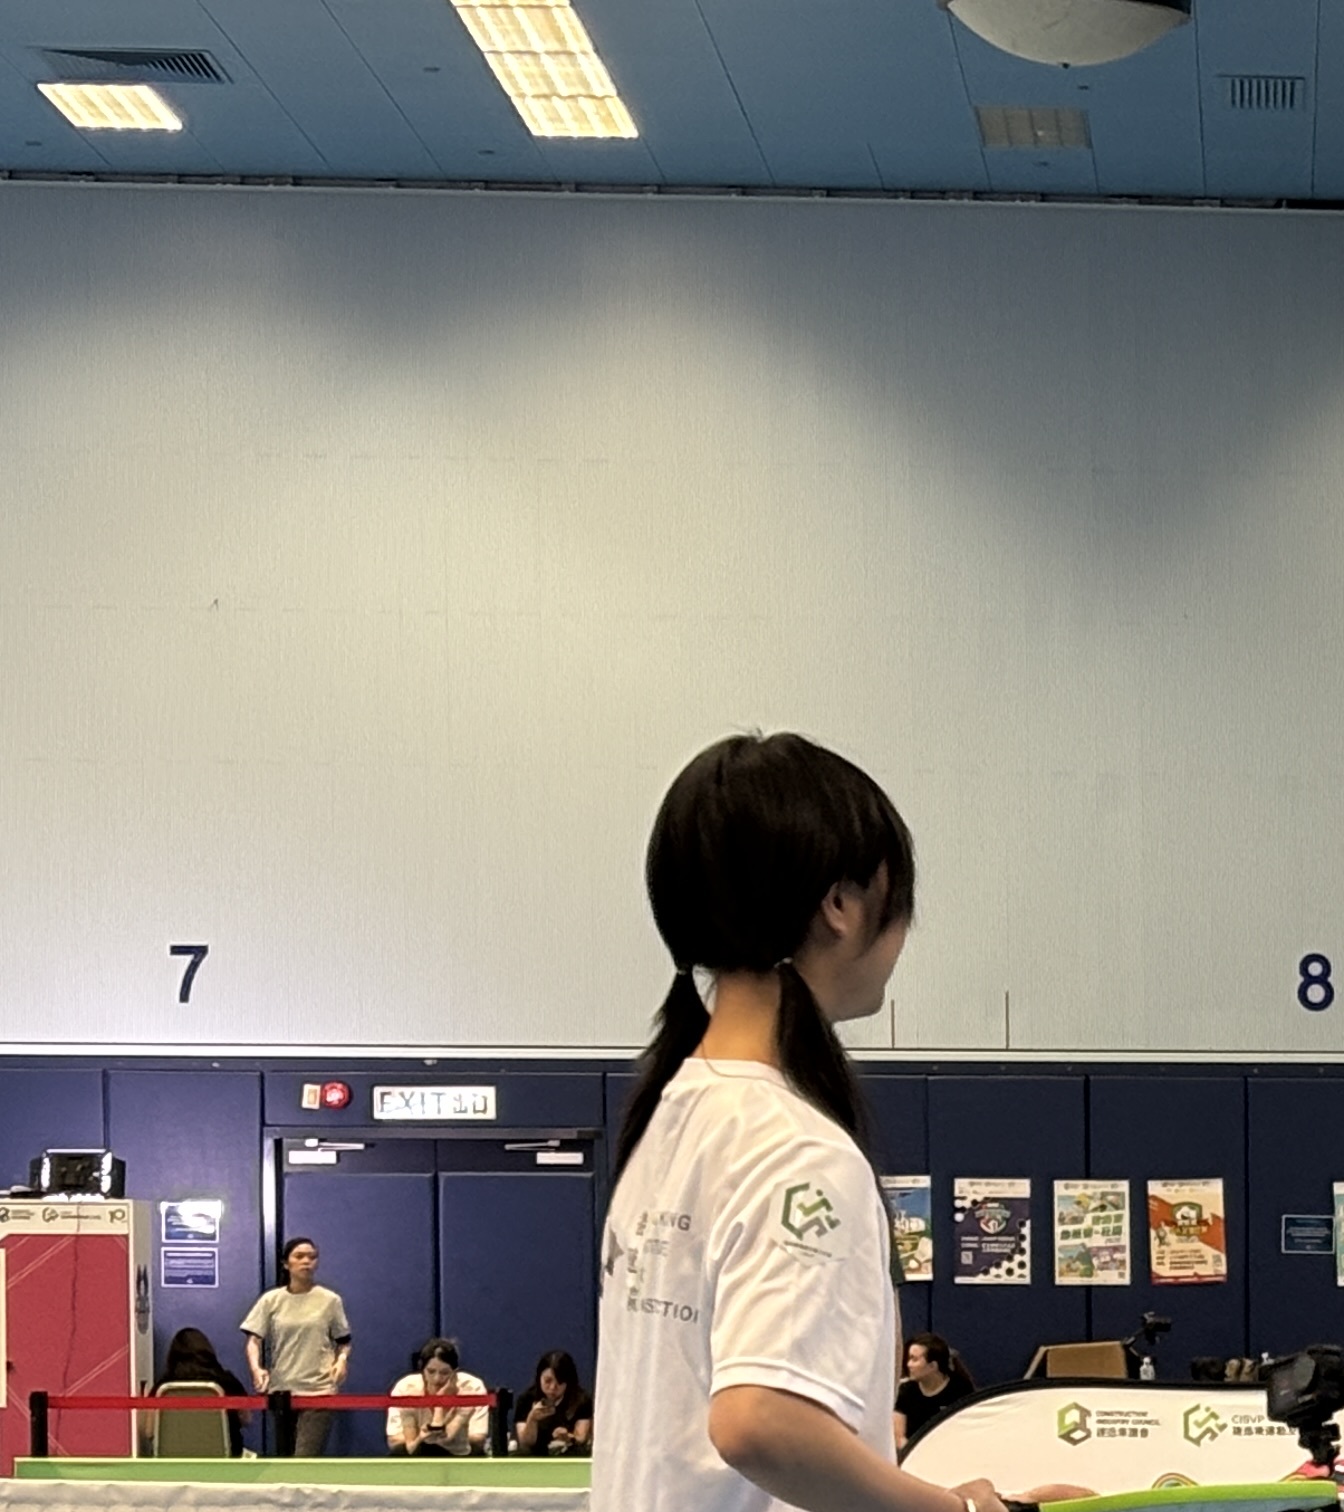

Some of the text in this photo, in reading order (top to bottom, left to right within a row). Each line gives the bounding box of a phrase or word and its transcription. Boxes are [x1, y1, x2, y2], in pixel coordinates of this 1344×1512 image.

[169, 944, 209, 1003] 7
[1297, 952, 1335, 1012] 8
[379, 1091, 446, 1115] EXIT
